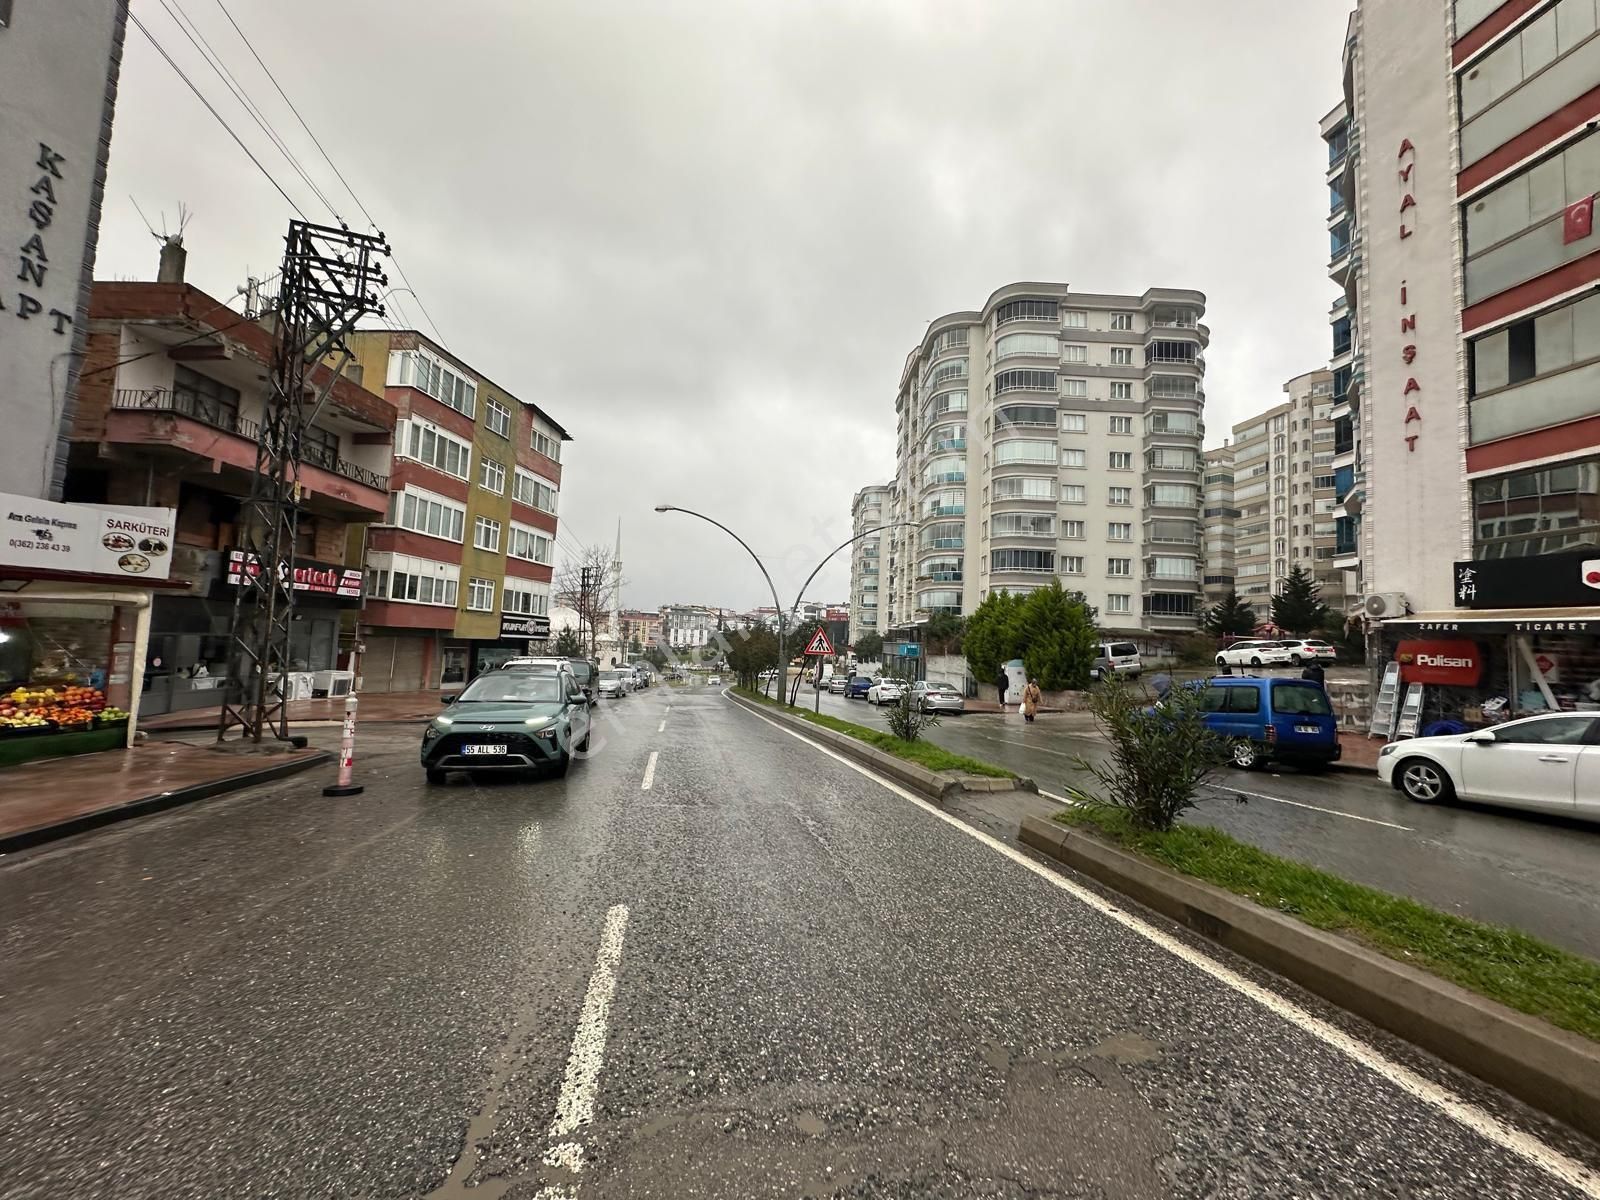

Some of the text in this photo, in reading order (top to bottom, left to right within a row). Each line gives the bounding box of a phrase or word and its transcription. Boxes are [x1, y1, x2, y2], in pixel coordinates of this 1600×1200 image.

[17, 142, 66, 288] KAŞAN
[1398, 137, 1421, 452] AYAL İNŞAAT
[106, 518, 170, 538] ŞARKÜTERİ
[1419, 622, 1588, 631] ZAFER TİCARET
[1416, 654, 1473, 668] Polisan
[466, 745, 475, 754] 55
[477, 745, 490, 754] ALL
